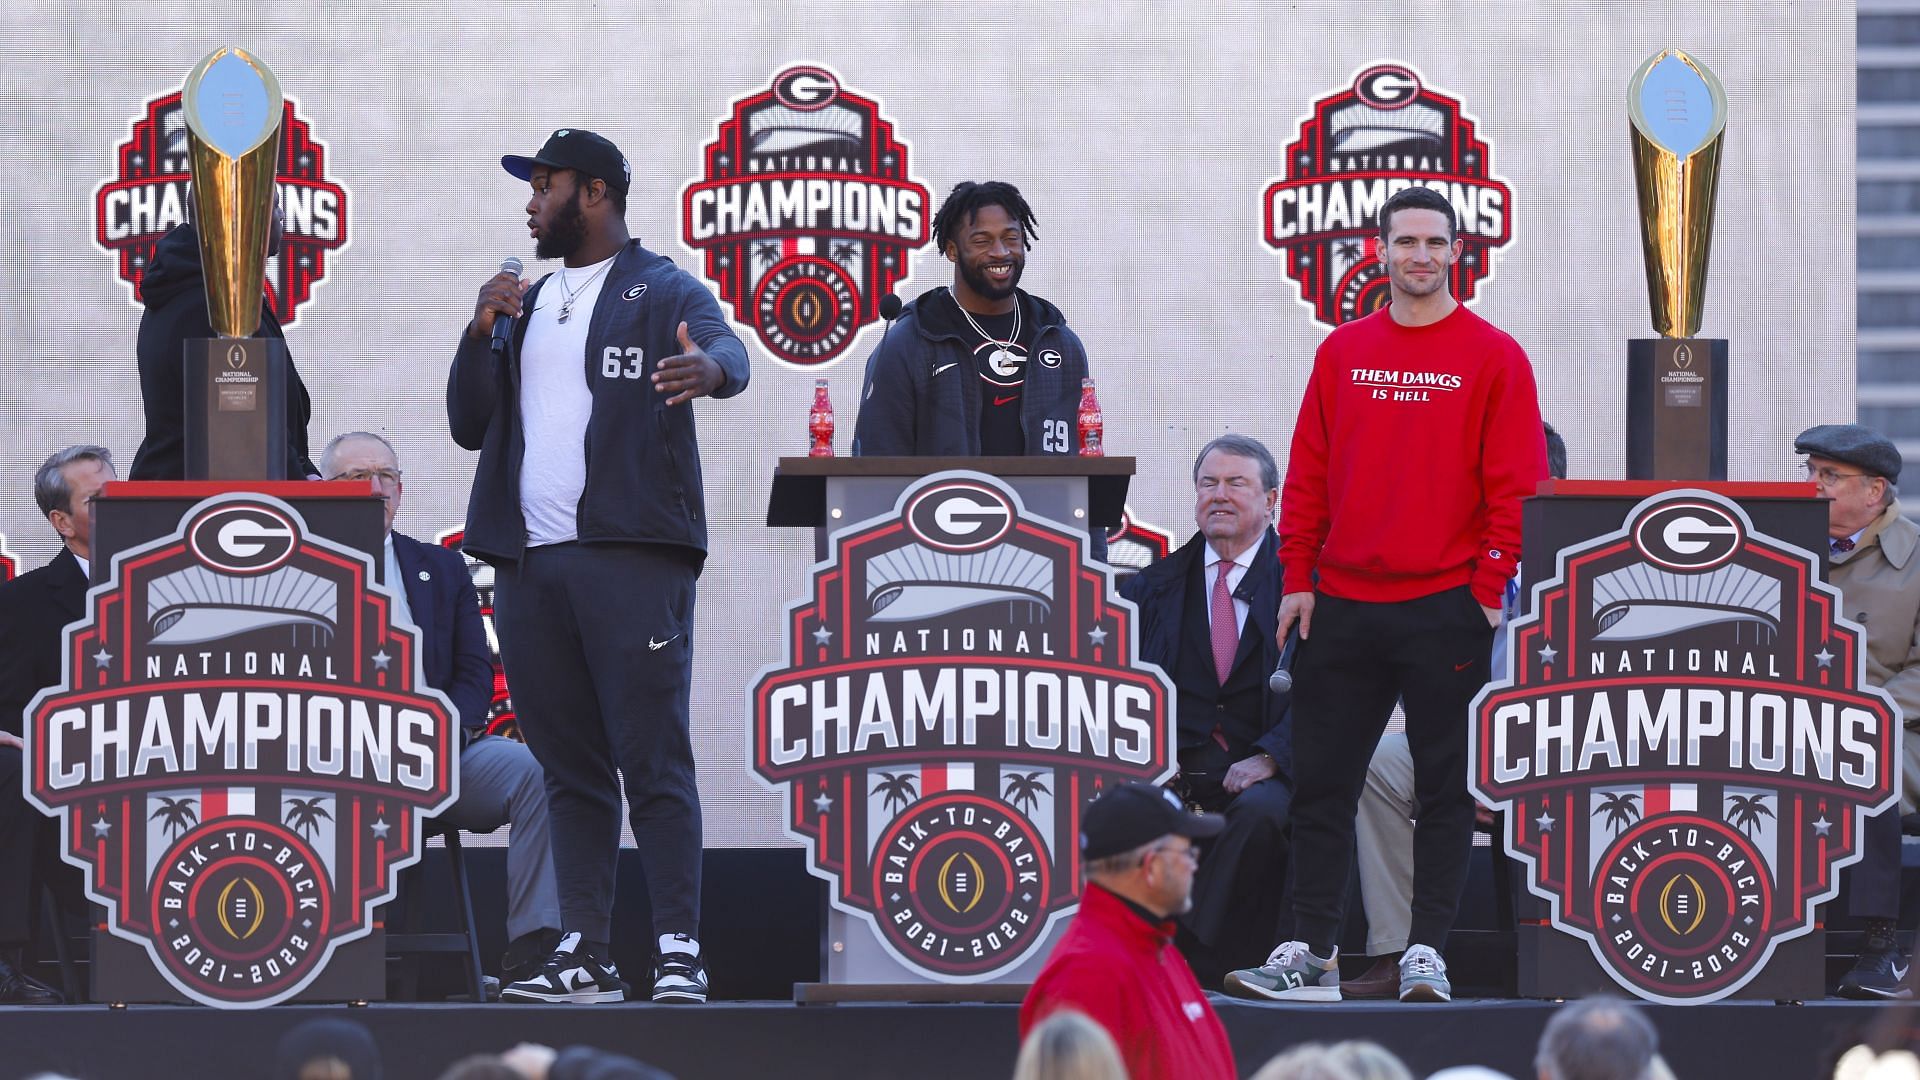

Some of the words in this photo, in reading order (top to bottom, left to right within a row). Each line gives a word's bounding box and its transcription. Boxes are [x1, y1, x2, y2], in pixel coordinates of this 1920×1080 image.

[790, 76, 837, 101] G
[1372, 75, 1418, 99] G
[749, 156, 863, 173] NATIONAL
[1331, 155, 1444, 172] NATIONAL
[105, 182, 337, 241] CHANS
[691, 179, 921, 241] CHAMPIONS
[1273, 179, 1502, 240] CHAMNS
[602, 346, 644, 379] 63
[1351, 369, 1399, 383] THEM
[1402, 371, 1462, 388] DAWGS
[1371, 389, 1388, 400] IS
[1393, 390, 1430, 402] HELL
[1043, 419, 1070, 453] 29
[934, 497, 1009, 535] G
[1663, 516, 1738, 554] G
[217, 519, 291, 557] G
[866, 628, 1055, 656] NATIONAL
[146, 651, 338, 680] NATIONAL
[1591, 648, 1780, 678] NATIONAL
[770, 667, 1151, 766] CHAMPIONS
[48, 691, 435, 791] CHAMPIONS
[1493, 688, 1877, 790] CHAMPIONS
[885, 807, 1037, 884] BACK-TO-BACK
[163, 832, 318, 910] BACK-TO-BACK
[1606, 828, 1759, 907] BACK-TO-BACK
[893, 908, 1029, 958] 2021-2022
[172, 933, 309, 984] 2021-2022
[1614, 929, 1750, 979] 2021-2022
